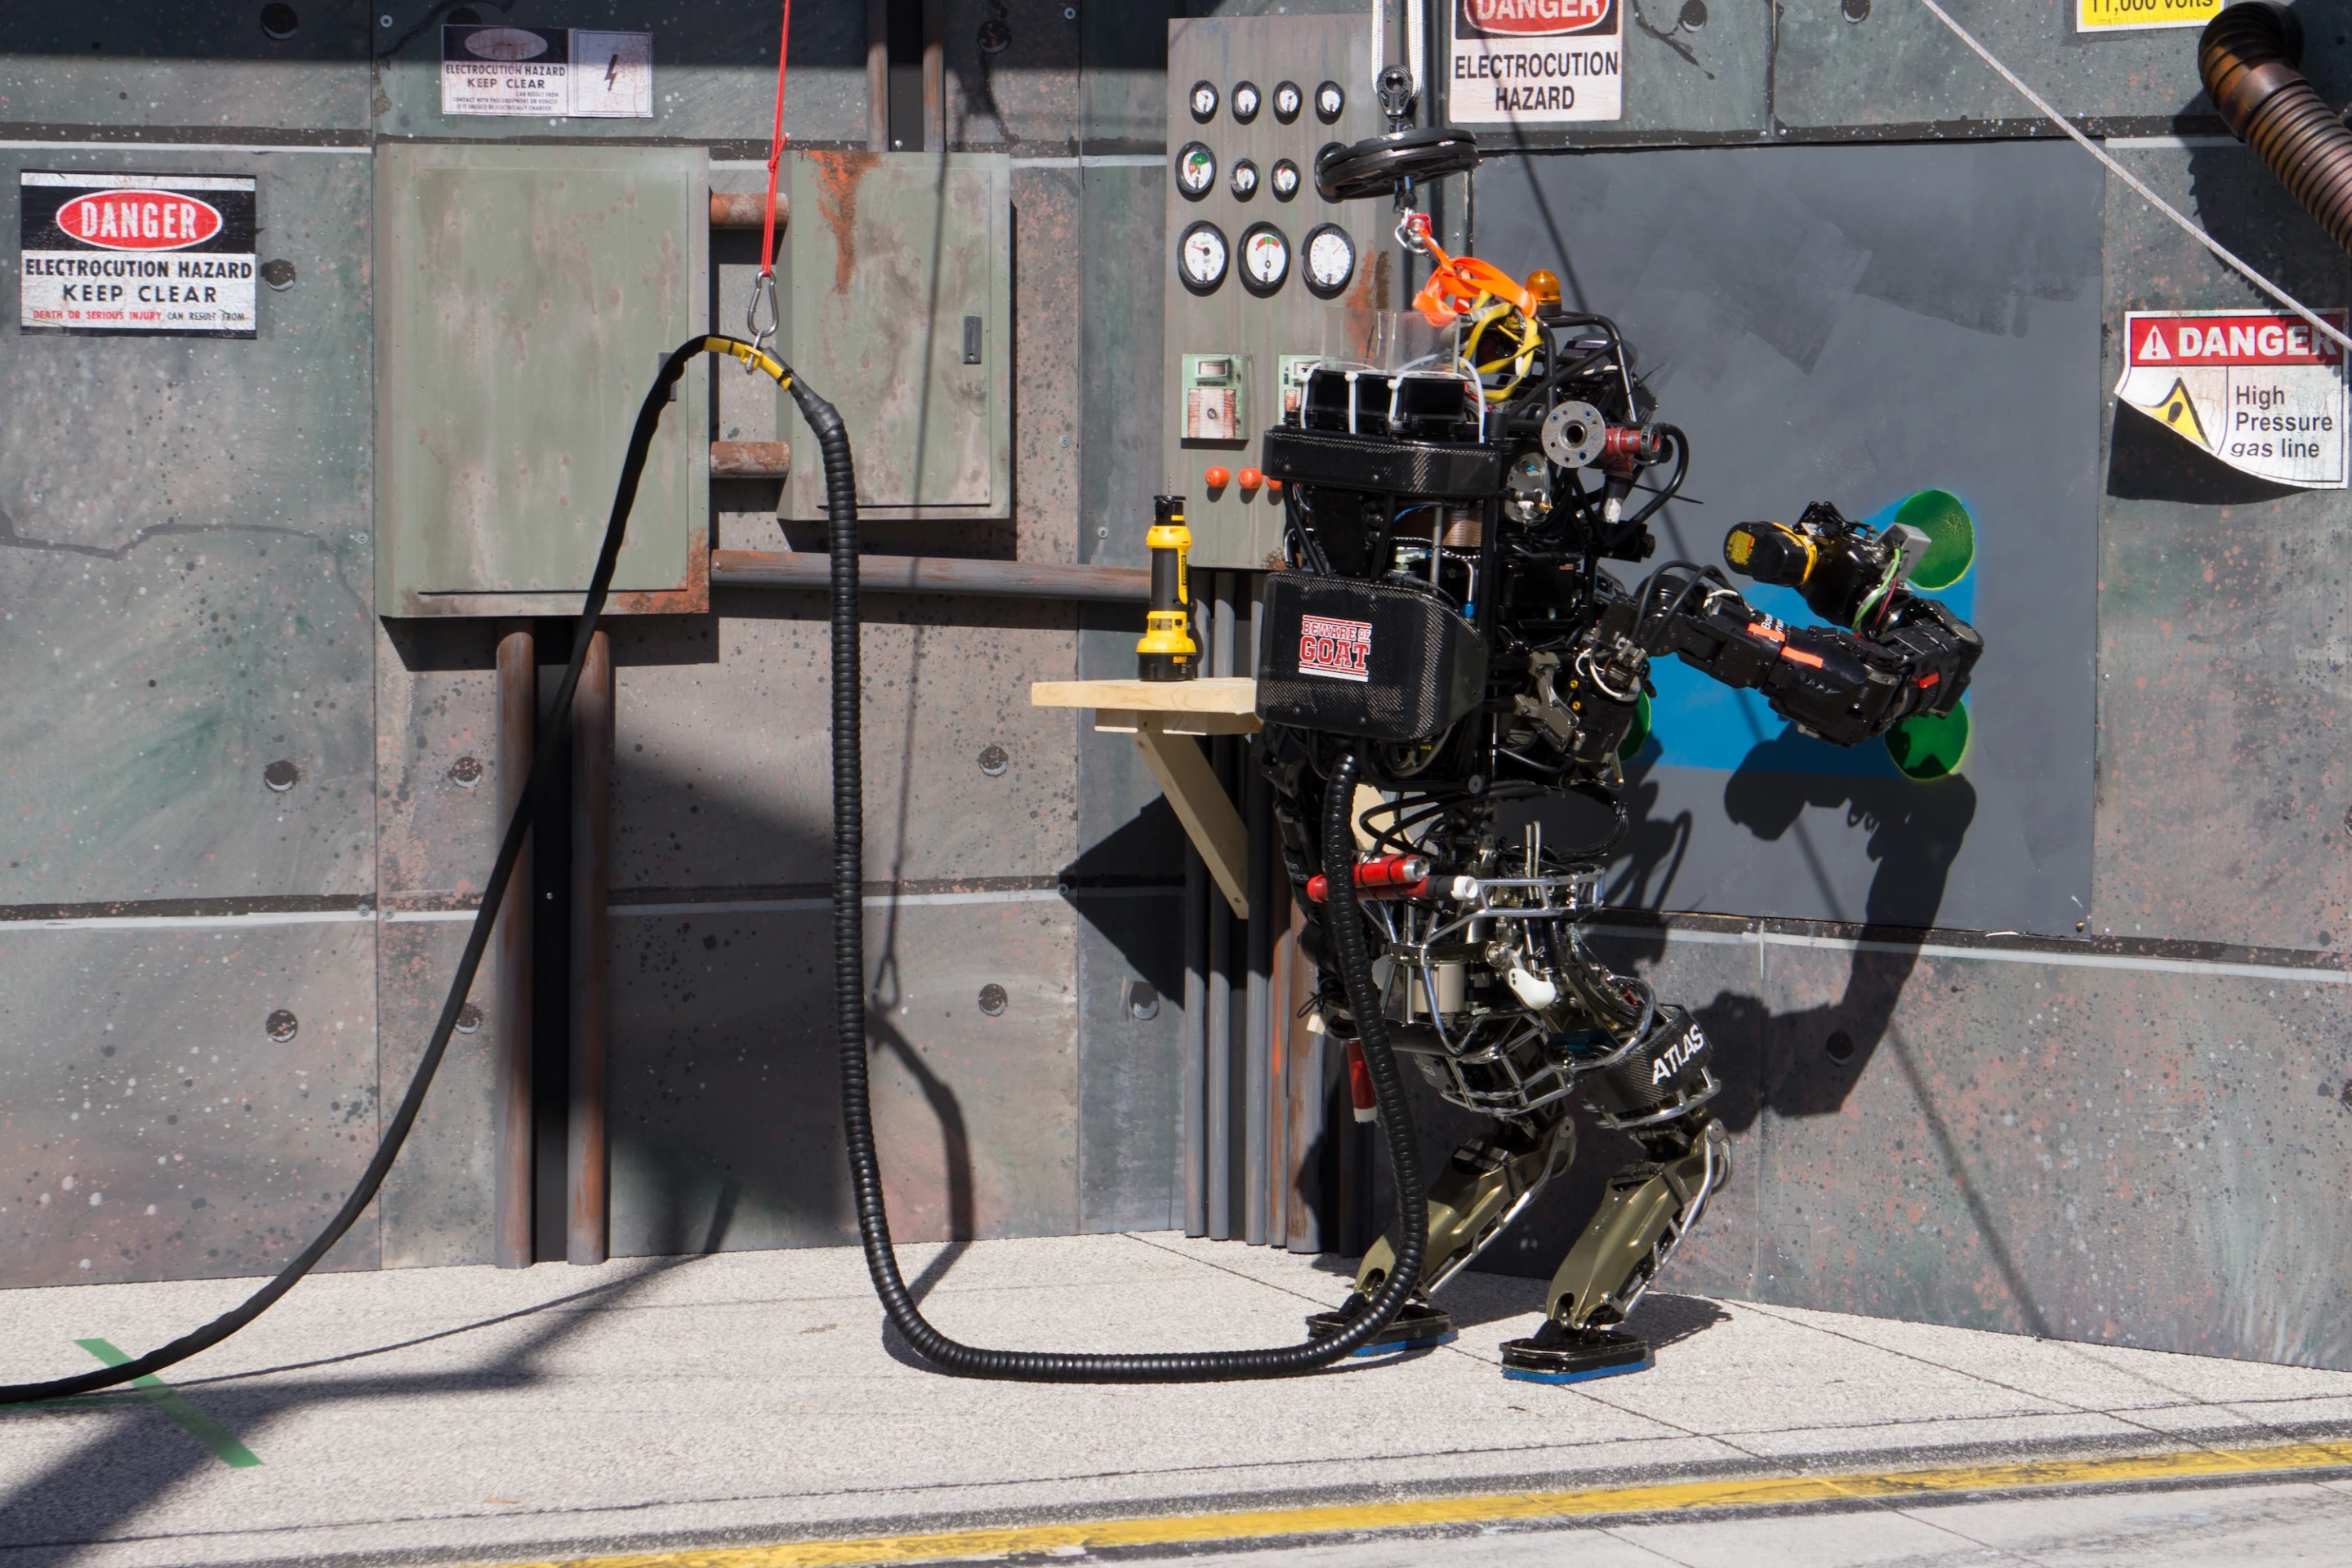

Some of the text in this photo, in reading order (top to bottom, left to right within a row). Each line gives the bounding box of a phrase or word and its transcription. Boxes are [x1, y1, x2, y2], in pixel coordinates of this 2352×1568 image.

[1477, 0, 1600, 20] DANGER
[446, 64, 566, 76] ELECTROCUTION HAZARD
[1455, 51, 1619, 79] ELECTROCUTION
[467, 78, 546, 89] KEEP CLEAR
[1495, 86, 1575, 111] HAZARD
[81, 202, 198, 239] DANGER
[25, 258, 252, 278] ELECTROCUTION HAZARD
[63, 284, 217, 303] KEEP CLEAR
[33, 310, 63, 319] DEATH
[68, 310, 81, 319] OR
[86, 310, 124, 320] SERIOUS
[129, 311, 163, 320] INJURY
[167, 312, 184, 321] CAN
[189, 312, 216, 321] RESULT
[2179, 326, 2338, 357] DANGER
[2235, 385, 2285, 408] High
[2235, 412, 2333, 431] Pressure
[2230, 439, 2320, 457] gas line
[1302, 621, 1371, 641] BEWARE OF
[1300, 635, 1370, 670] GOAT
[1652, 1024, 1704, 1085] ATLAS
